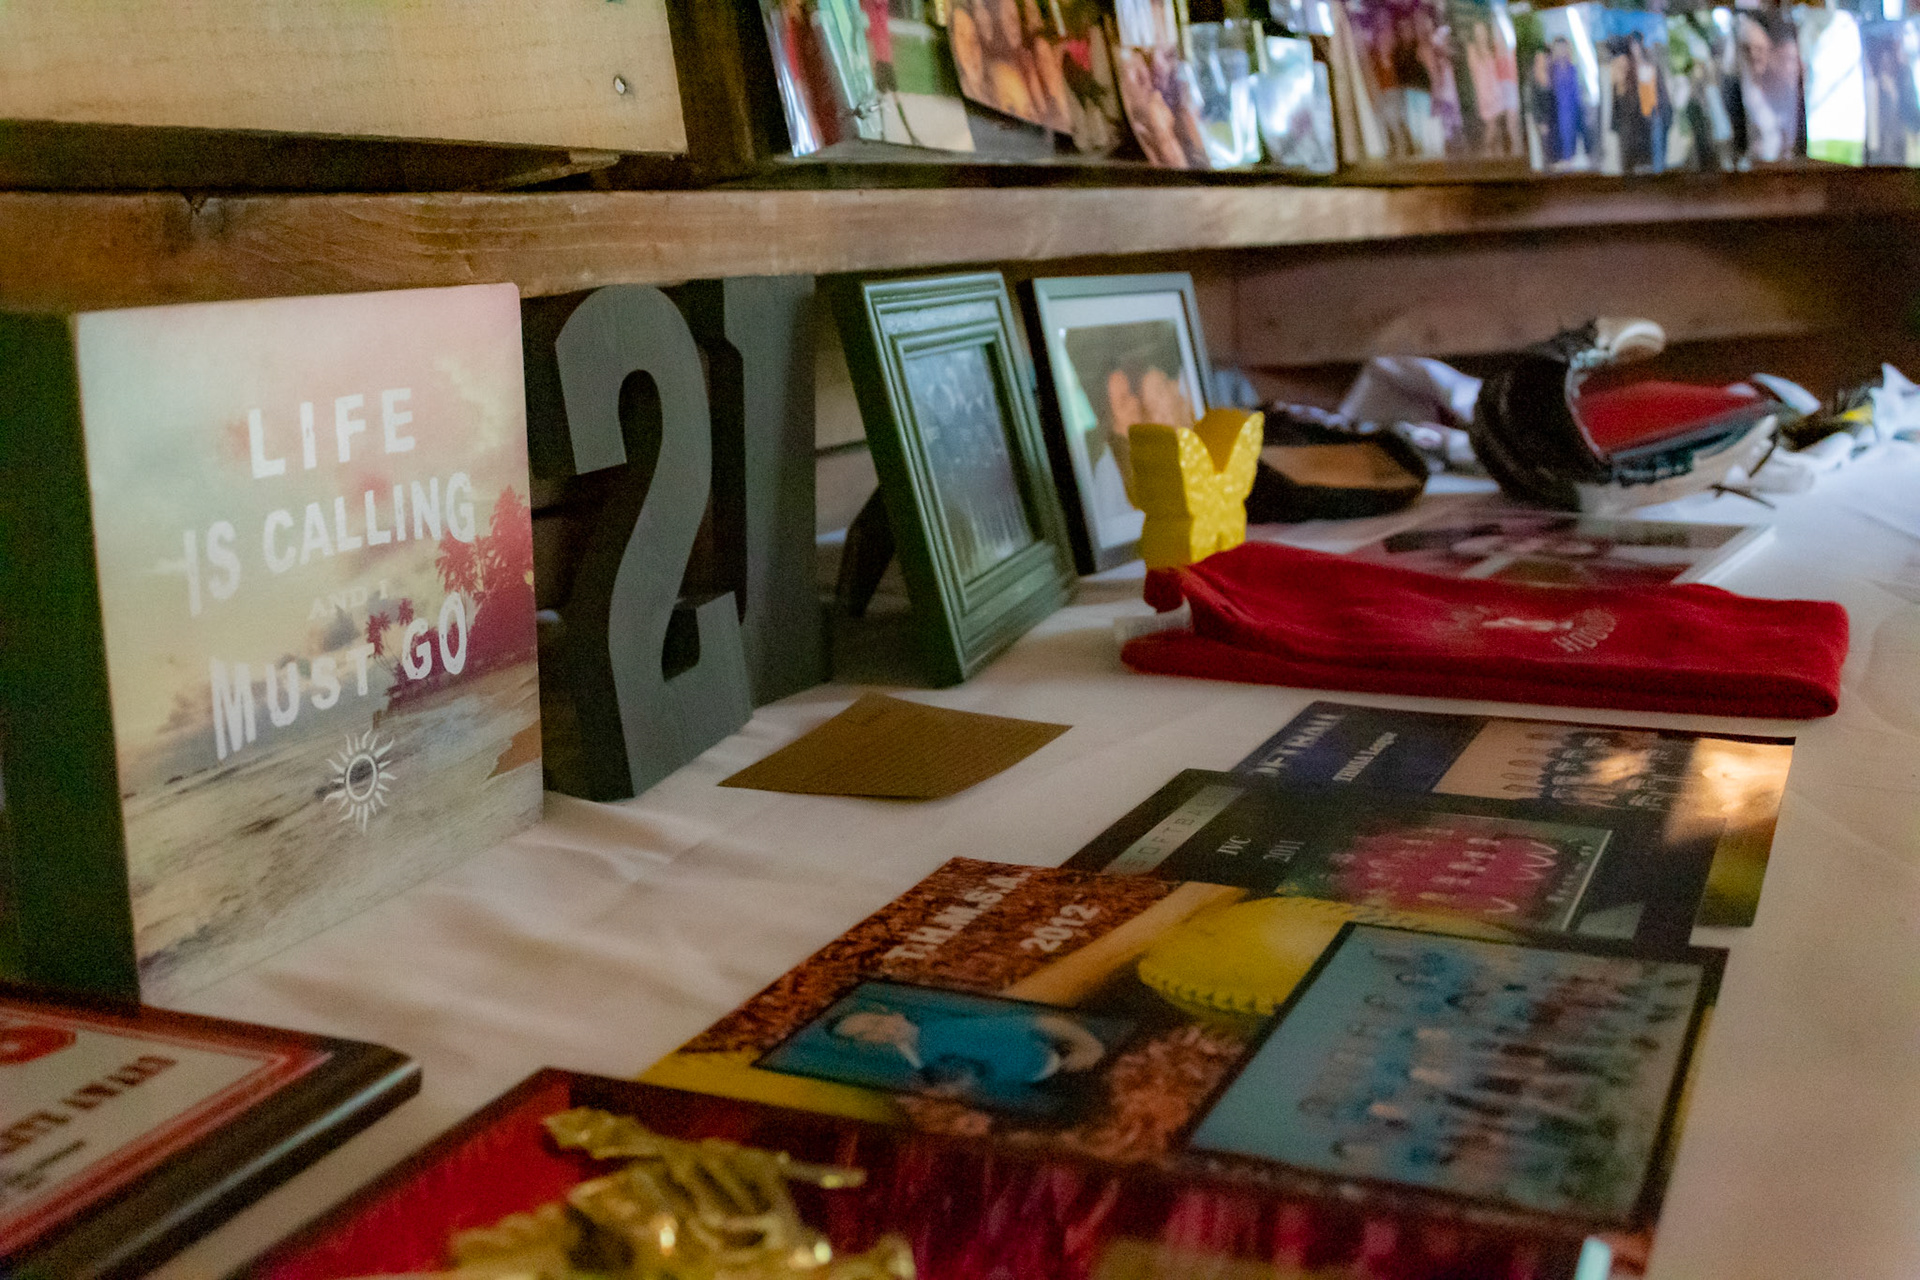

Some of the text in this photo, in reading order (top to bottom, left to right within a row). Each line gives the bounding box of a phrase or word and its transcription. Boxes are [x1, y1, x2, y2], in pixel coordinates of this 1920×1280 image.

[247, 388, 417, 480] LIFE
[182, 471, 476, 617] IS CALLING
[308, 585, 369, 620] AND
[209, 590, 470, 762] MUST GO
[1123, 788, 1224, 868] SOFTBAL
[1262, 838, 1306, 863] 2011
[1020, 902, 1102, 953] 2012
